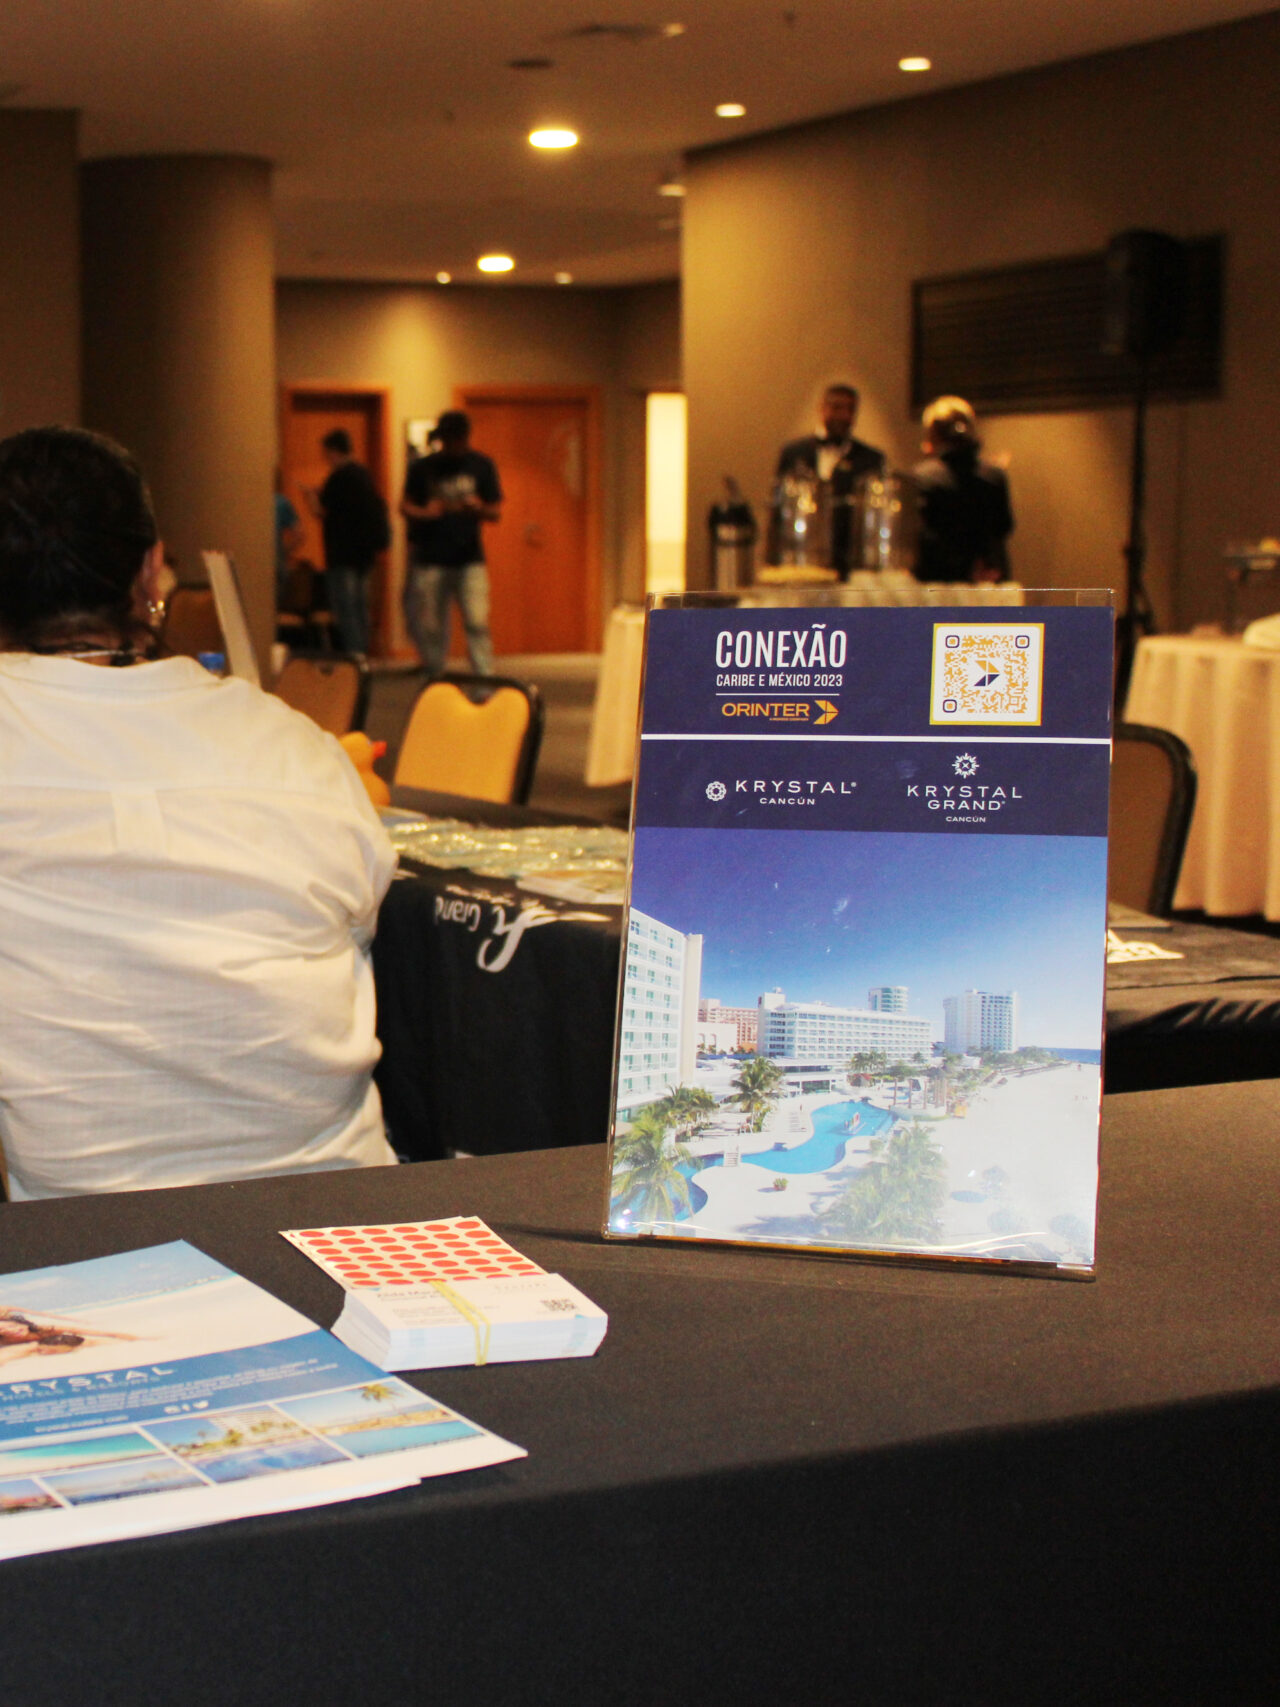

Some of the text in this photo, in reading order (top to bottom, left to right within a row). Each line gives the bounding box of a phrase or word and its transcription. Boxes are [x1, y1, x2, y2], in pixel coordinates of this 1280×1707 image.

[715, 623, 847, 668] CONEXÃO
[716, 671, 843, 687] CARIBE E MÉXICO 2023
[721, 702, 811, 717] ORINTER
[906, 784, 1023, 799] KRYSTAL
[759, 796, 816, 806] CANCÚN
[945, 815, 987, 823] CANCÚN
